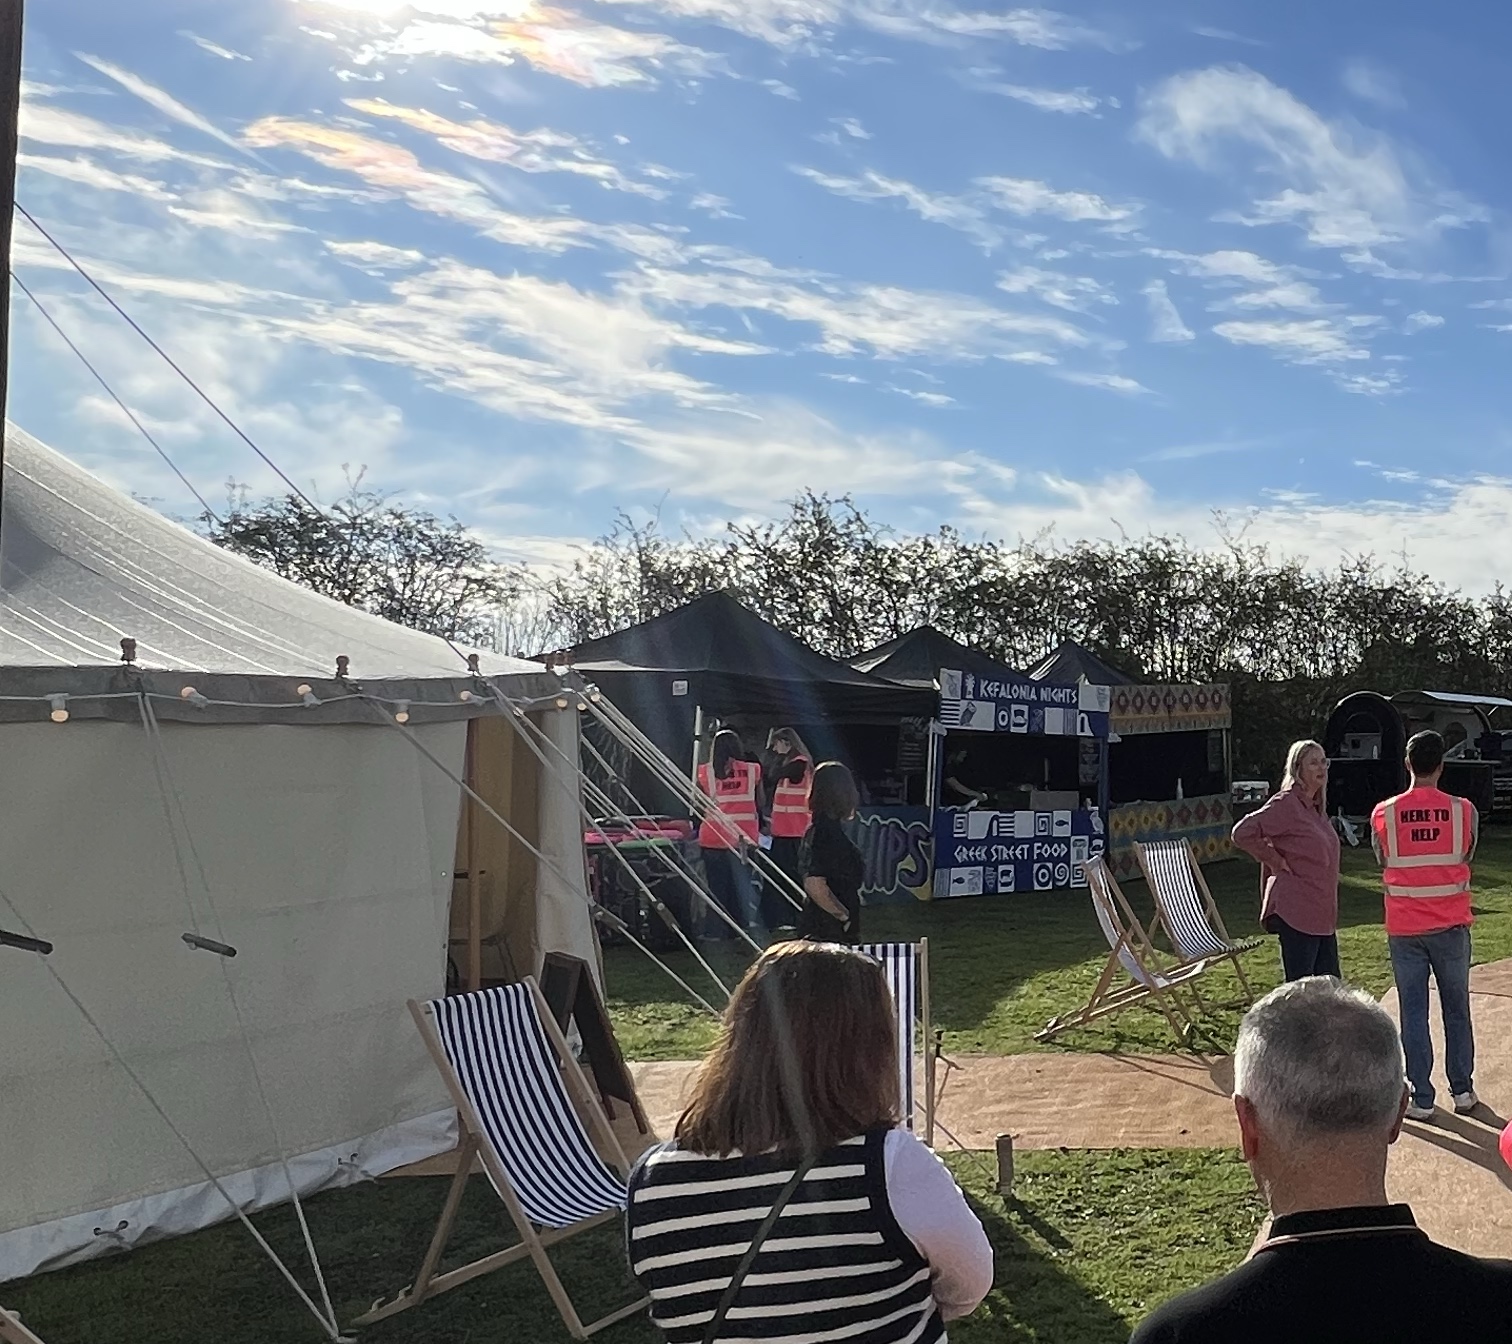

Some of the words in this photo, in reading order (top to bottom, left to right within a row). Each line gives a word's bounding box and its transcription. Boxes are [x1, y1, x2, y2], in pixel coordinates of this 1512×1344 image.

[979, 679, 1037, 701] KEFALONIA
[1040, 686, 1077, 704] NIGHTS
[1400, 809, 1431, 823] HERE
[1433, 808, 1450, 822] TO
[1411, 828, 1440, 842] HELP
[953, 844, 988, 863] GREEK
[990, 844, 1030, 862] STREET
[1033, 842, 1068, 860] FOOD
